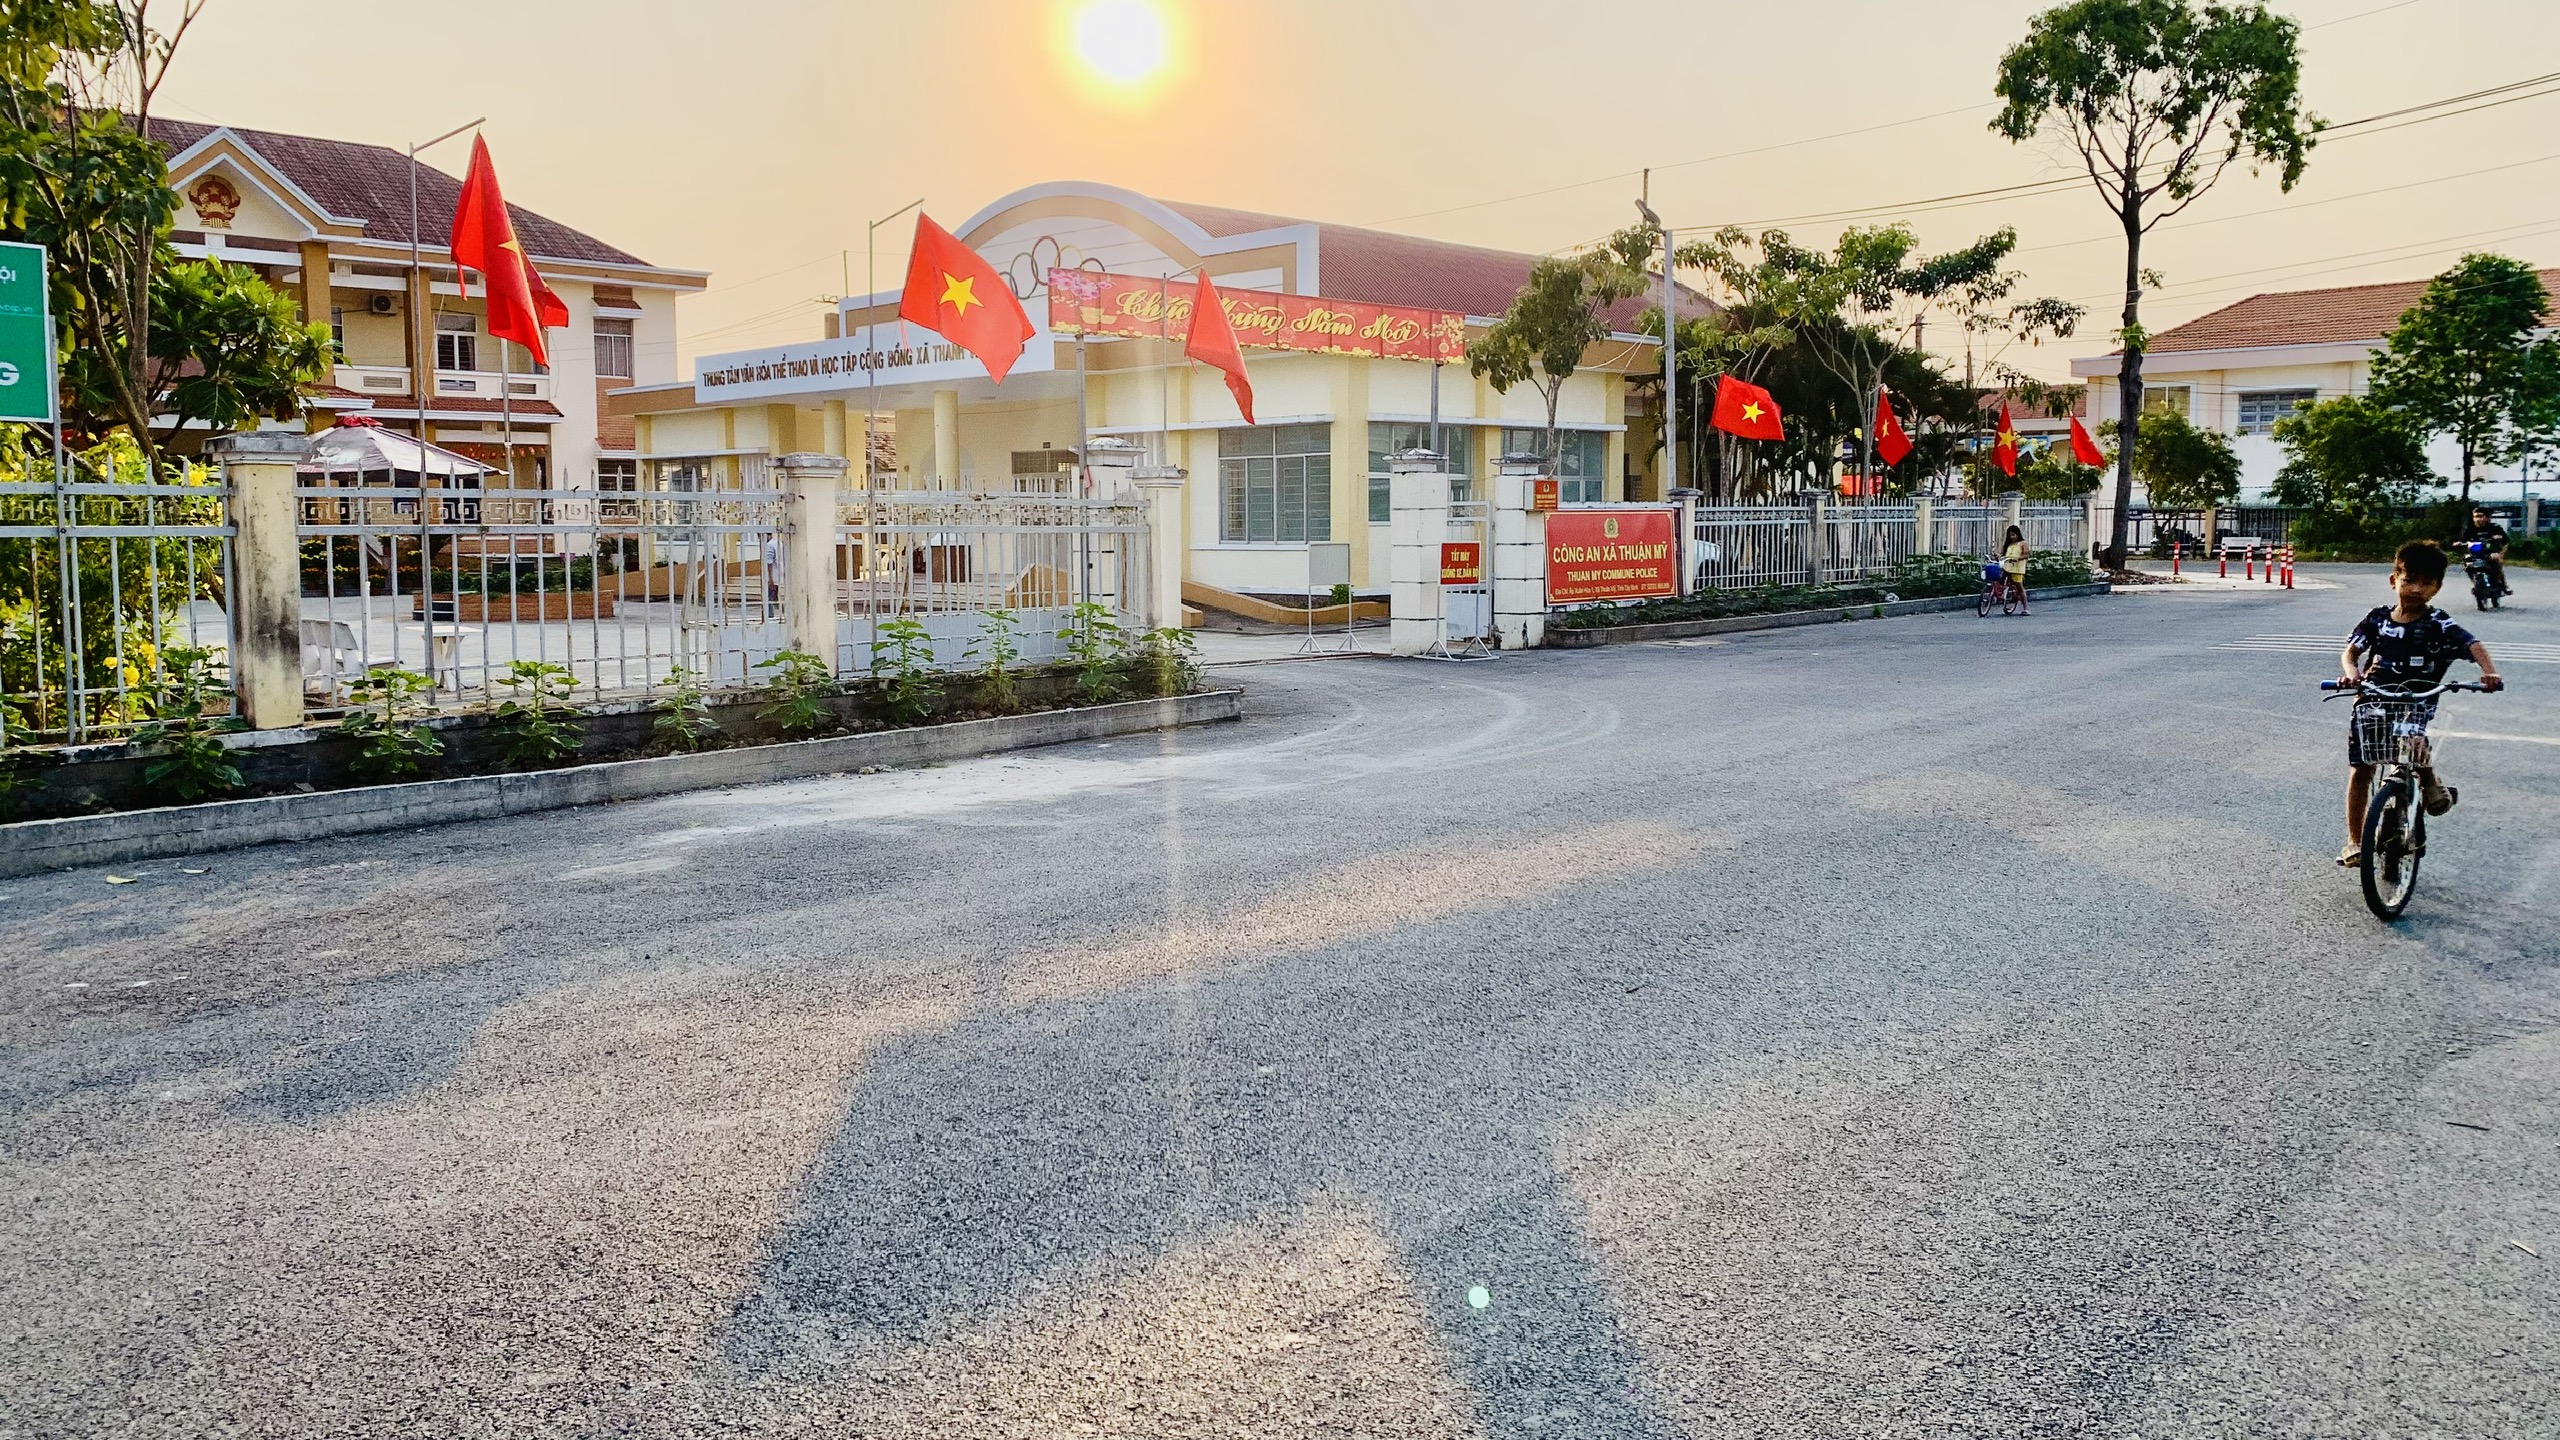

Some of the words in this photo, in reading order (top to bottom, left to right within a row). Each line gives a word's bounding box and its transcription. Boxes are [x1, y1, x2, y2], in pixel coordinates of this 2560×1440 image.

[1115, 289, 1194, 323] Chúc
[1291, 307, 1357, 336] Năm
[1359, 313, 1420, 345] Mới
[726, 365, 740, 385] TÂM
[740, 363, 755, 383] VĂN
[756, 360, 772, 381] HÓA
[772, 353, 787, 379] THỂ
[787, 360, 808, 378] THAO
[809, 354, 819, 376] VÀ
[821, 355, 839, 378] HỌC
[841, 351, 857, 376] TẬP
[859, 348, 884, 374] CỘNG
[887, 342, 913, 368] ĐỒNG
[916, 342, 930, 364] XÃ
[1553, 543, 1584, 563] CÔNG
[1586, 546, 1601, 562] AN
[1603, 542, 1617, 561] XÃ
[1618, 541, 1652, 563] THUẬN
[1654, 541, 1668, 560] MỸ
[1567, 570, 1591, 582] THUAN
[1591, 570, 1602, 581] MY
[1602, 568, 1635, 580] COMMUNE
[1635, 567, 1658, 578] POLICE
